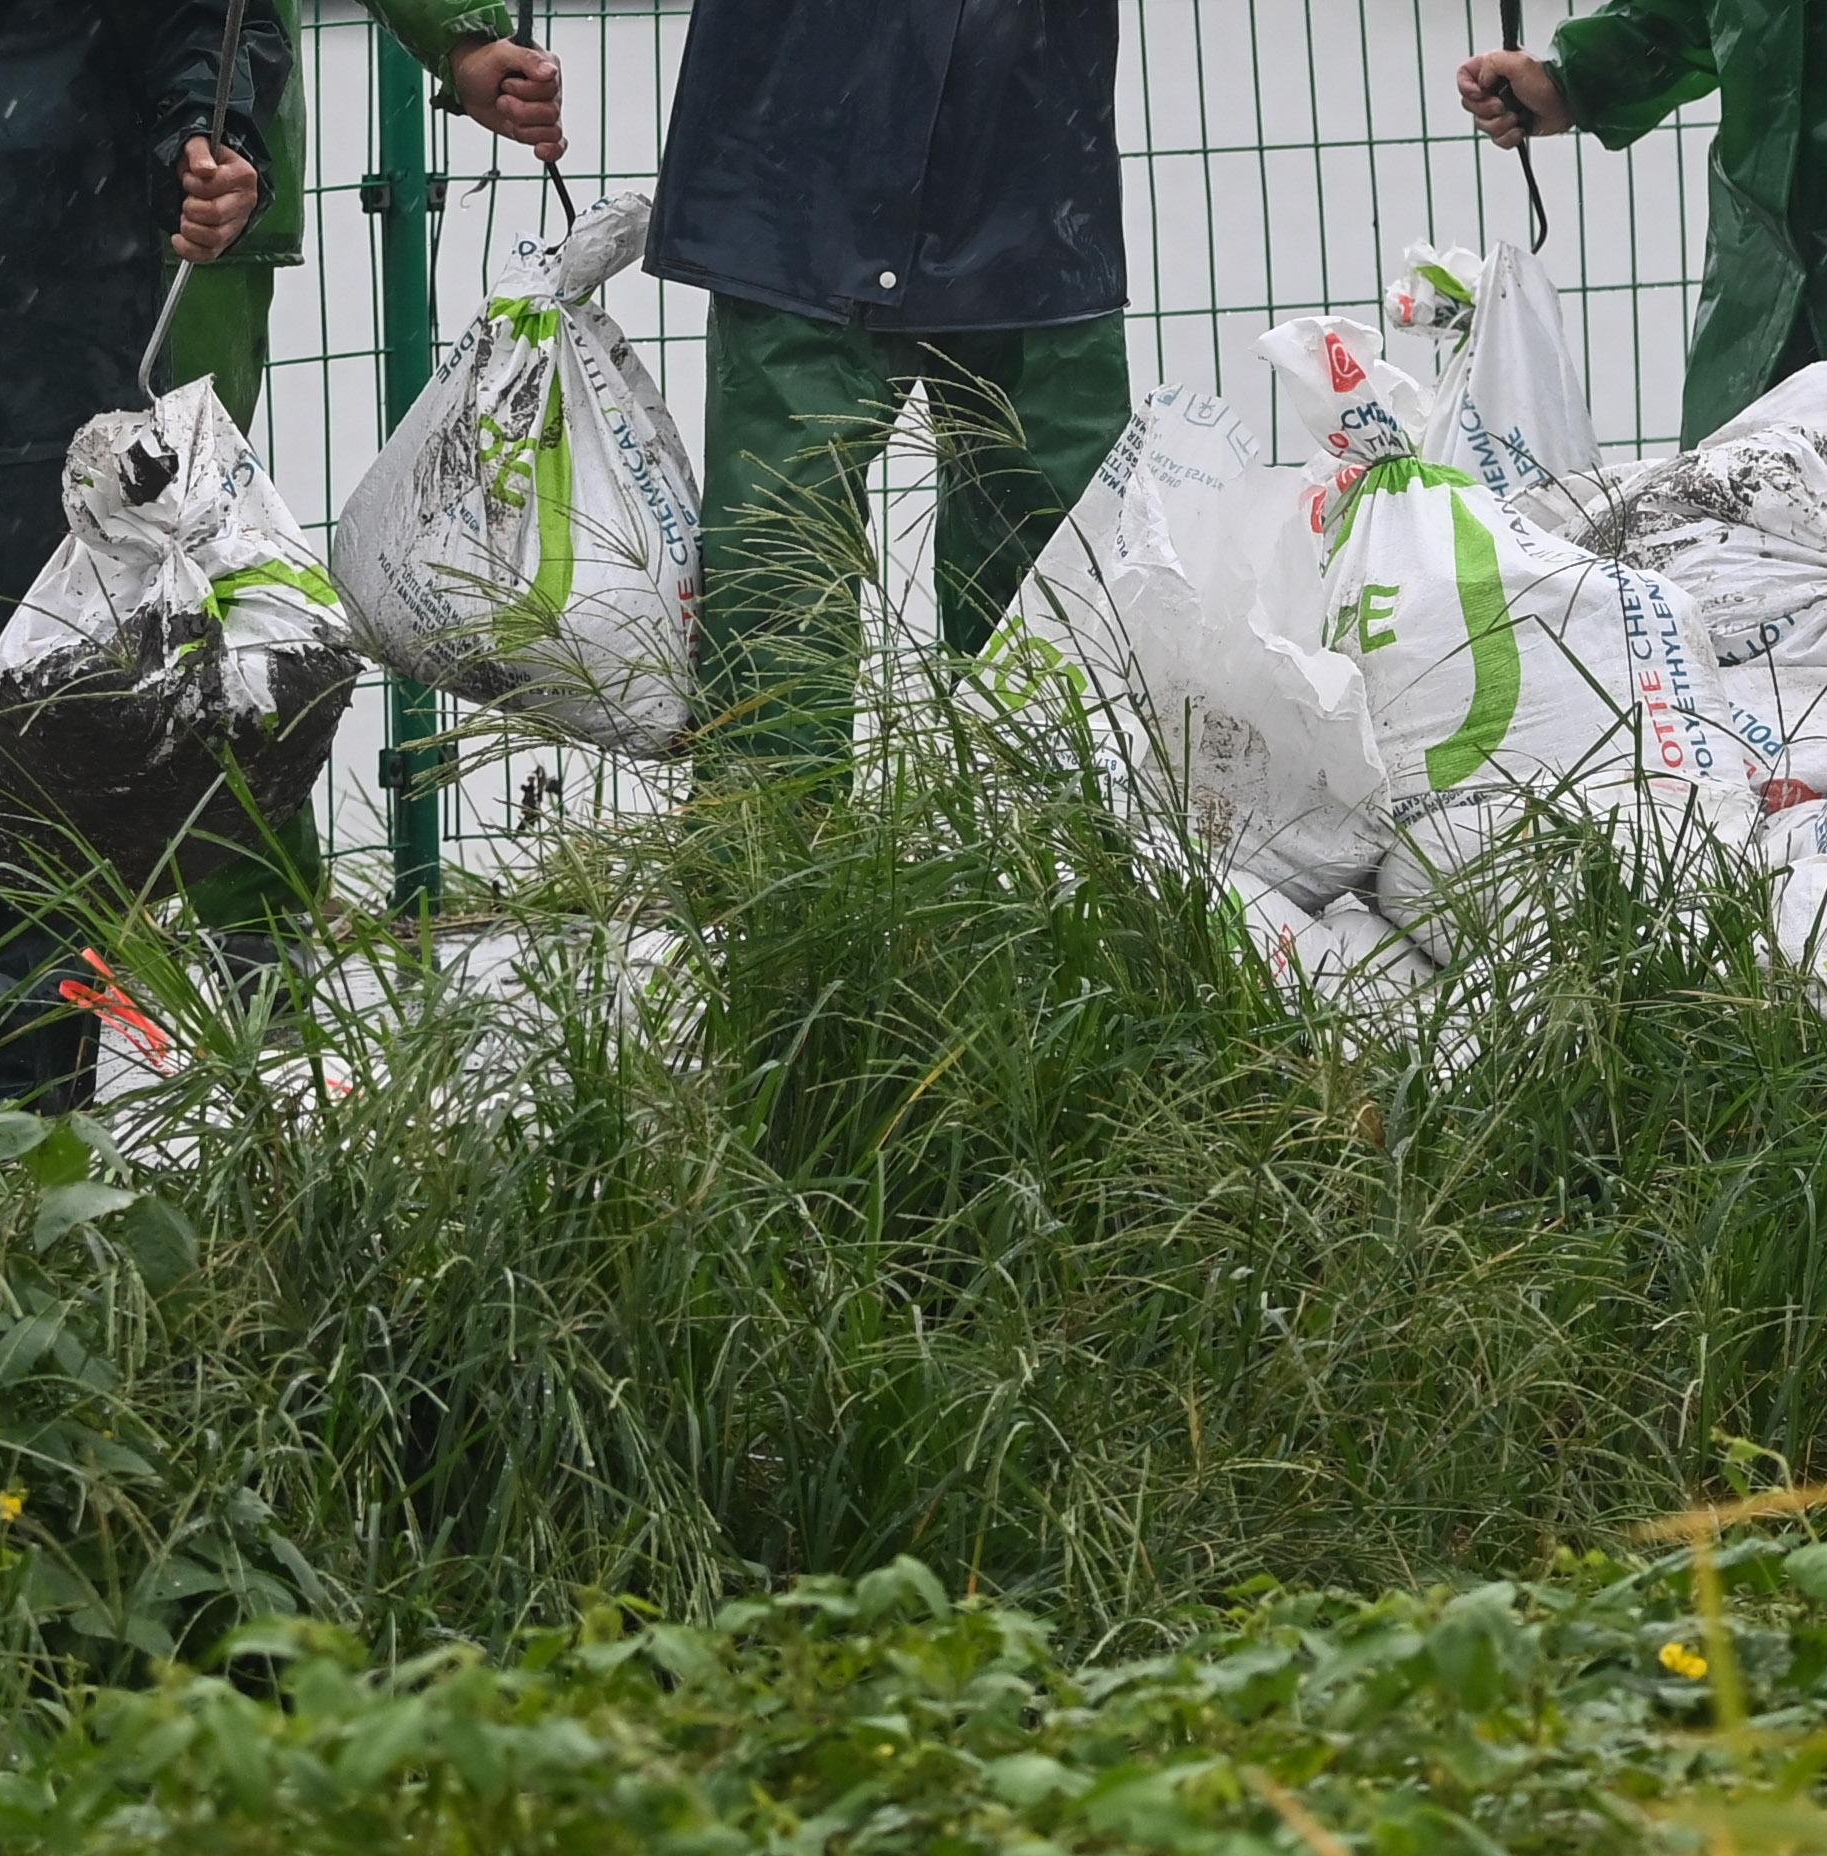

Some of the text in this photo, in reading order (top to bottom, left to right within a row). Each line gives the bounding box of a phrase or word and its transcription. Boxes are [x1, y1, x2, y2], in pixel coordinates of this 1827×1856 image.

[612, 415, 687, 566] CHEMICAL
[1507, 425, 1545, 485] LENE
[419, 591, 449, 627] CHEMICA
[1637, 669, 1685, 769] OTTE
